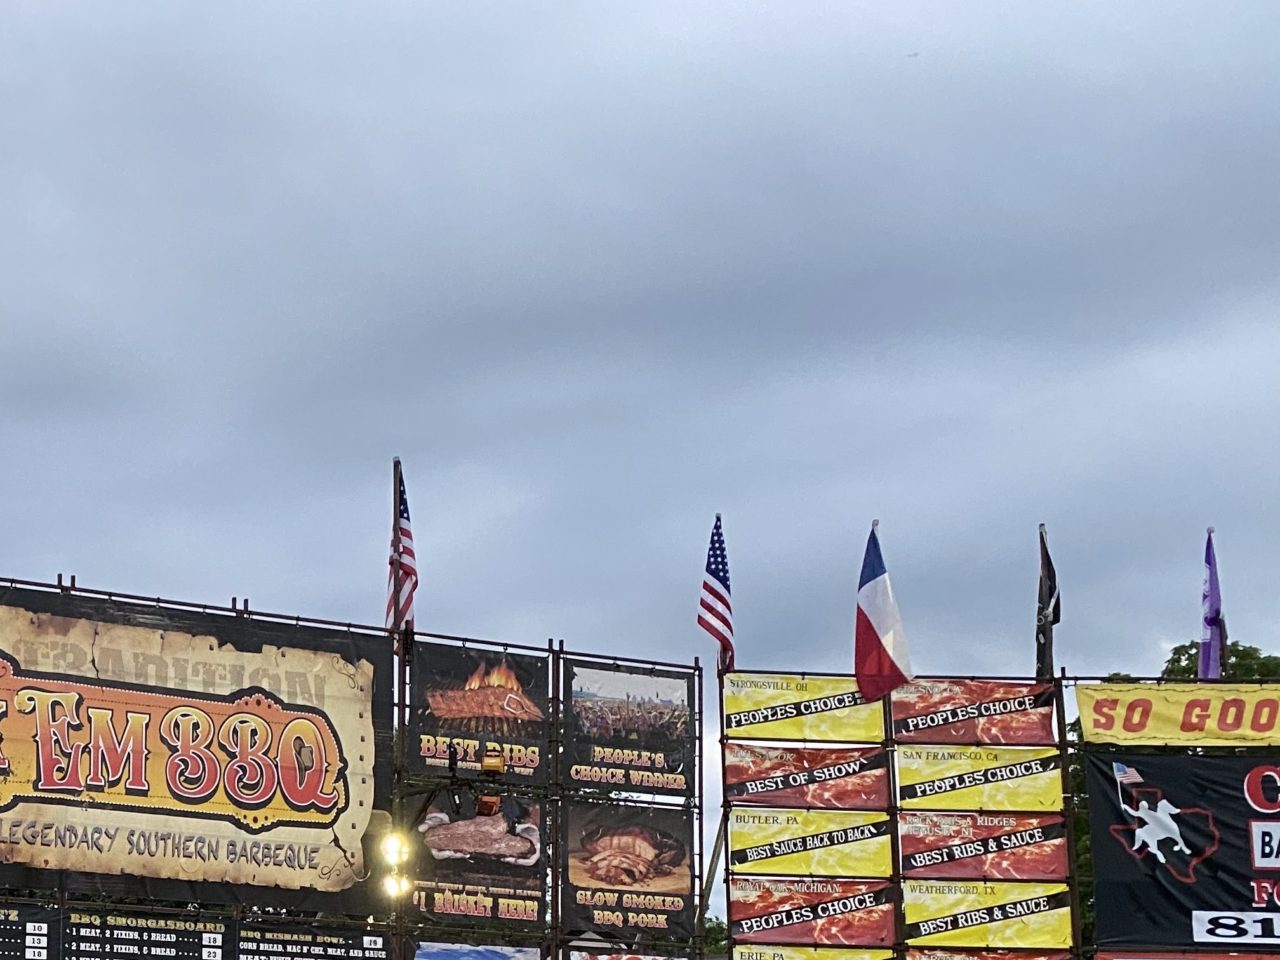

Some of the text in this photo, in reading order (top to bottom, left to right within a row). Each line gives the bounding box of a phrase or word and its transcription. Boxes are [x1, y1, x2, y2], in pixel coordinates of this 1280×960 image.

[729, 679, 808, 692] STRONGSVILLE, OH
[730, 694, 854, 728] PEOPLES CHOICE
[907, 696, 1035, 730] PEOPLES CHOICE
[1093, 698, 1280, 732] SO GOO
[160, 706, 339, 810] BBQ
[420, 734, 480, 761] BEST
[903, 751, 999, 761] SAN FRANCISCO, CA
[570, 765, 686, 790] CHOICE WINNER
[746, 761, 861, 794] BEST OF SHOW
[915, 761, 1042, 797] PEOPLES CHOICE
[735, 814, 799, 825] BUTLER, PA
[128, 830, 220, 863] SOUTHERN
[227, 840, 321, 872] BARBEQUE
[746, 825, 871, 861] BEST SAUCE BACK TO BACK
[912, 828, 1044, 868] BEST RIBS & SAUCE
[576, 890, 684, 911] SLOW SMOKED
[910, 885, 996, 896] WEATHERFORD, TX
[434, 891, 538, 921] BRISKET HERE!
[593, 910, 668, 929] BBQ PORK
[919, 898, 1049, 936] BEST RIBS & SAUCE
[70, 913, 225, 933] BBQ SMORGASBOARD
[740, 952, 768, 960] ERIE,
